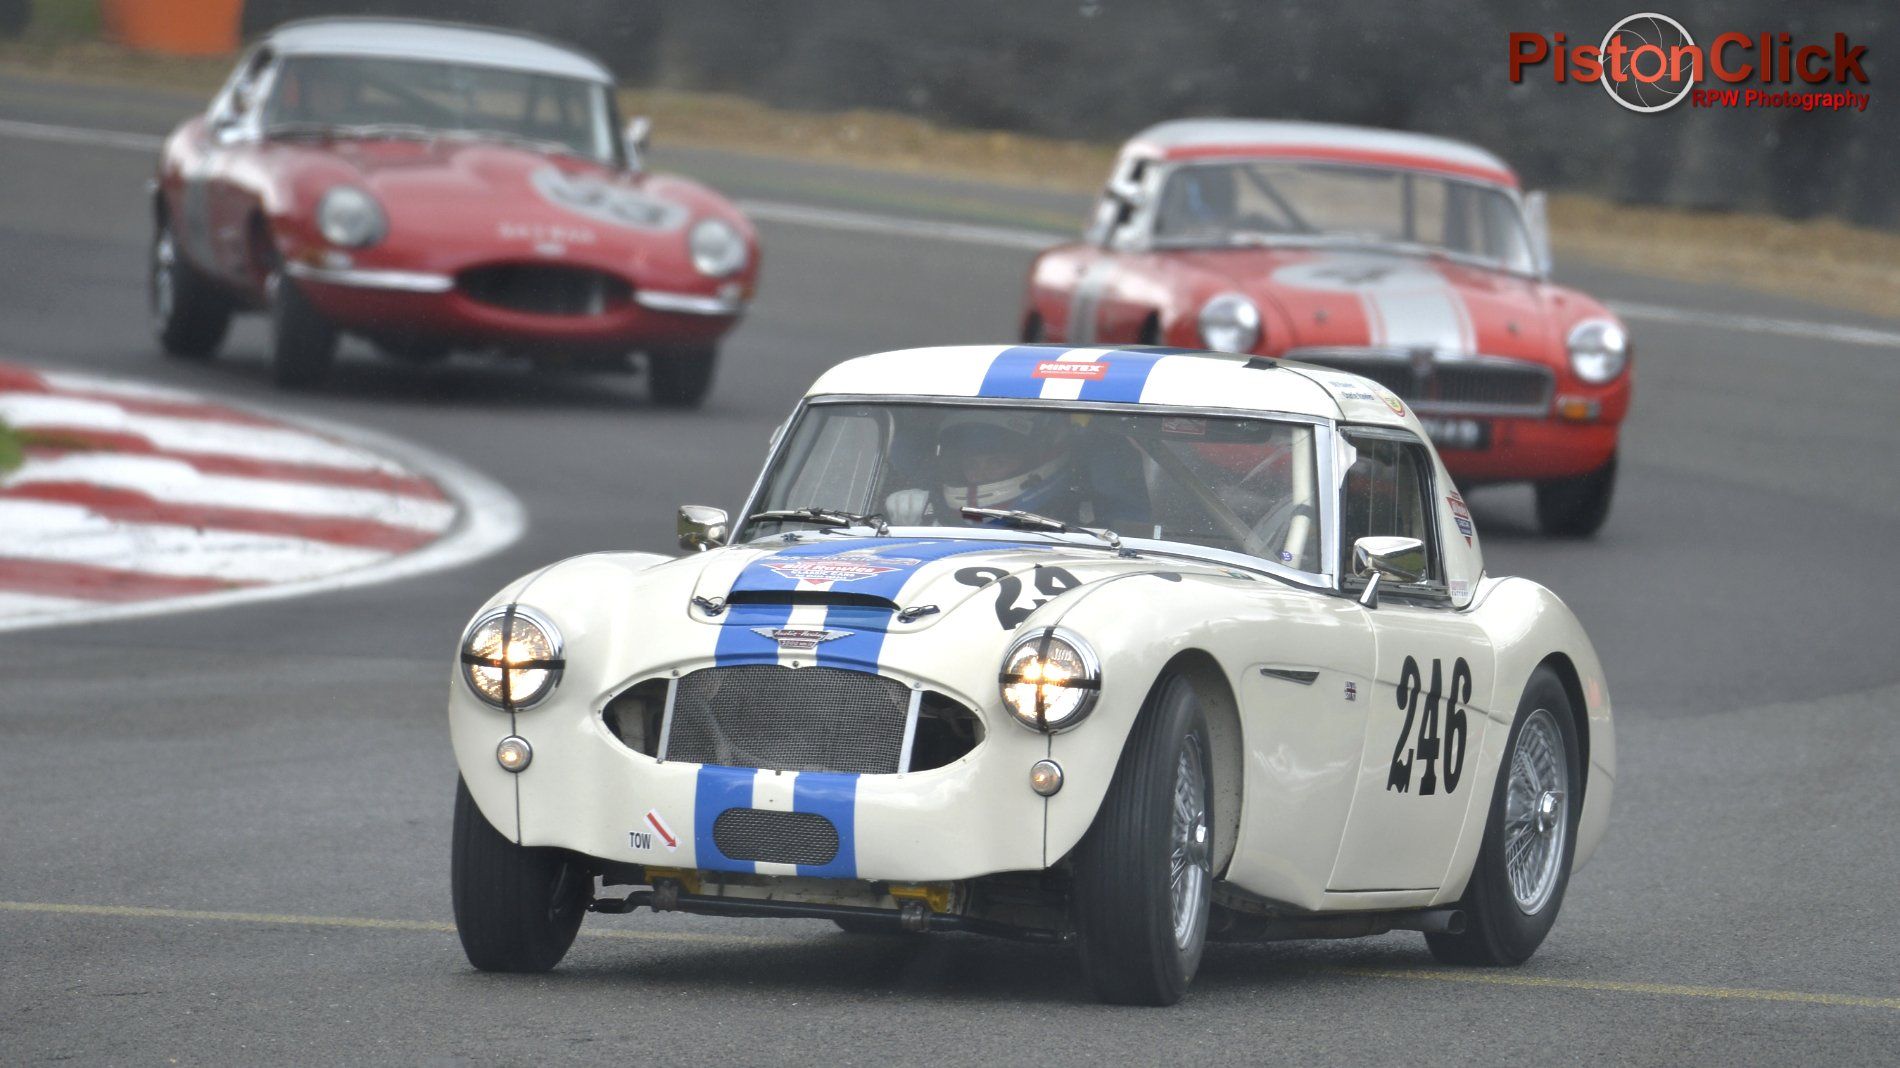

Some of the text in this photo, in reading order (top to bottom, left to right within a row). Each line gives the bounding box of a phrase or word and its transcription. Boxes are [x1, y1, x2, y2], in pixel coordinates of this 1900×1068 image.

[1039, 363, 1104, 372] MINTEX
[1387, 655, 1472, 795] 246
[629, 832, 651, 850] TOW
